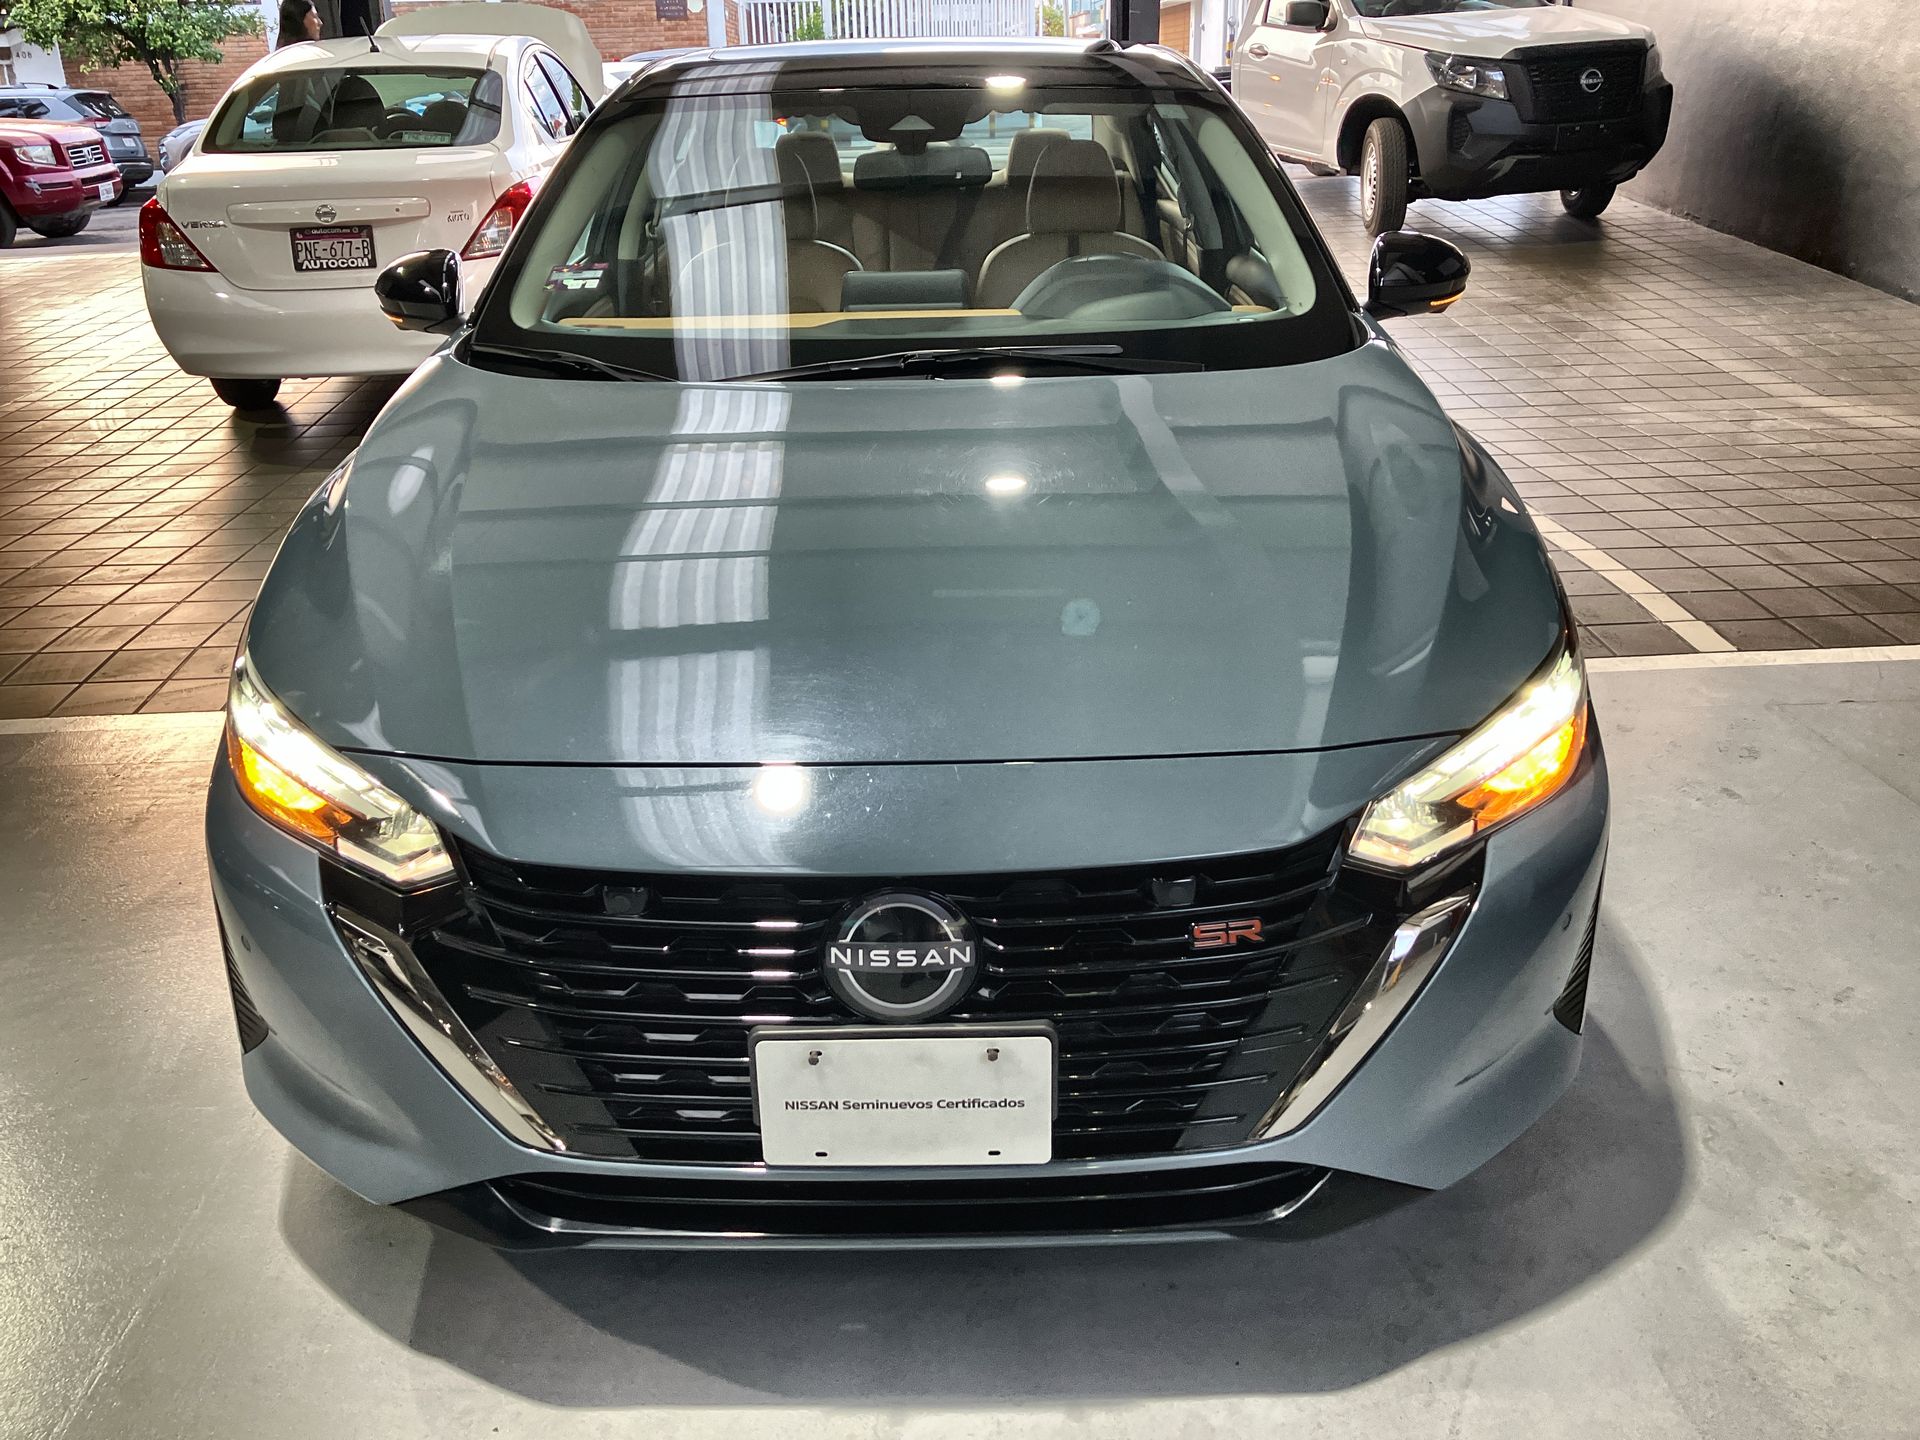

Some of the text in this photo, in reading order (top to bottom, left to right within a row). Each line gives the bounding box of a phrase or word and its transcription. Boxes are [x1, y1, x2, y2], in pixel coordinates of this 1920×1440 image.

[296, 240, 370, 260] PNE-677-B
[302, 258, 369, 270] AUTOCOM
[1193, 918, 1264, 948] SR
[830, 946, 971, 967] NISSAN
[785, 1097, 1025, 1110] NISSAN Seminuevos Certificados
